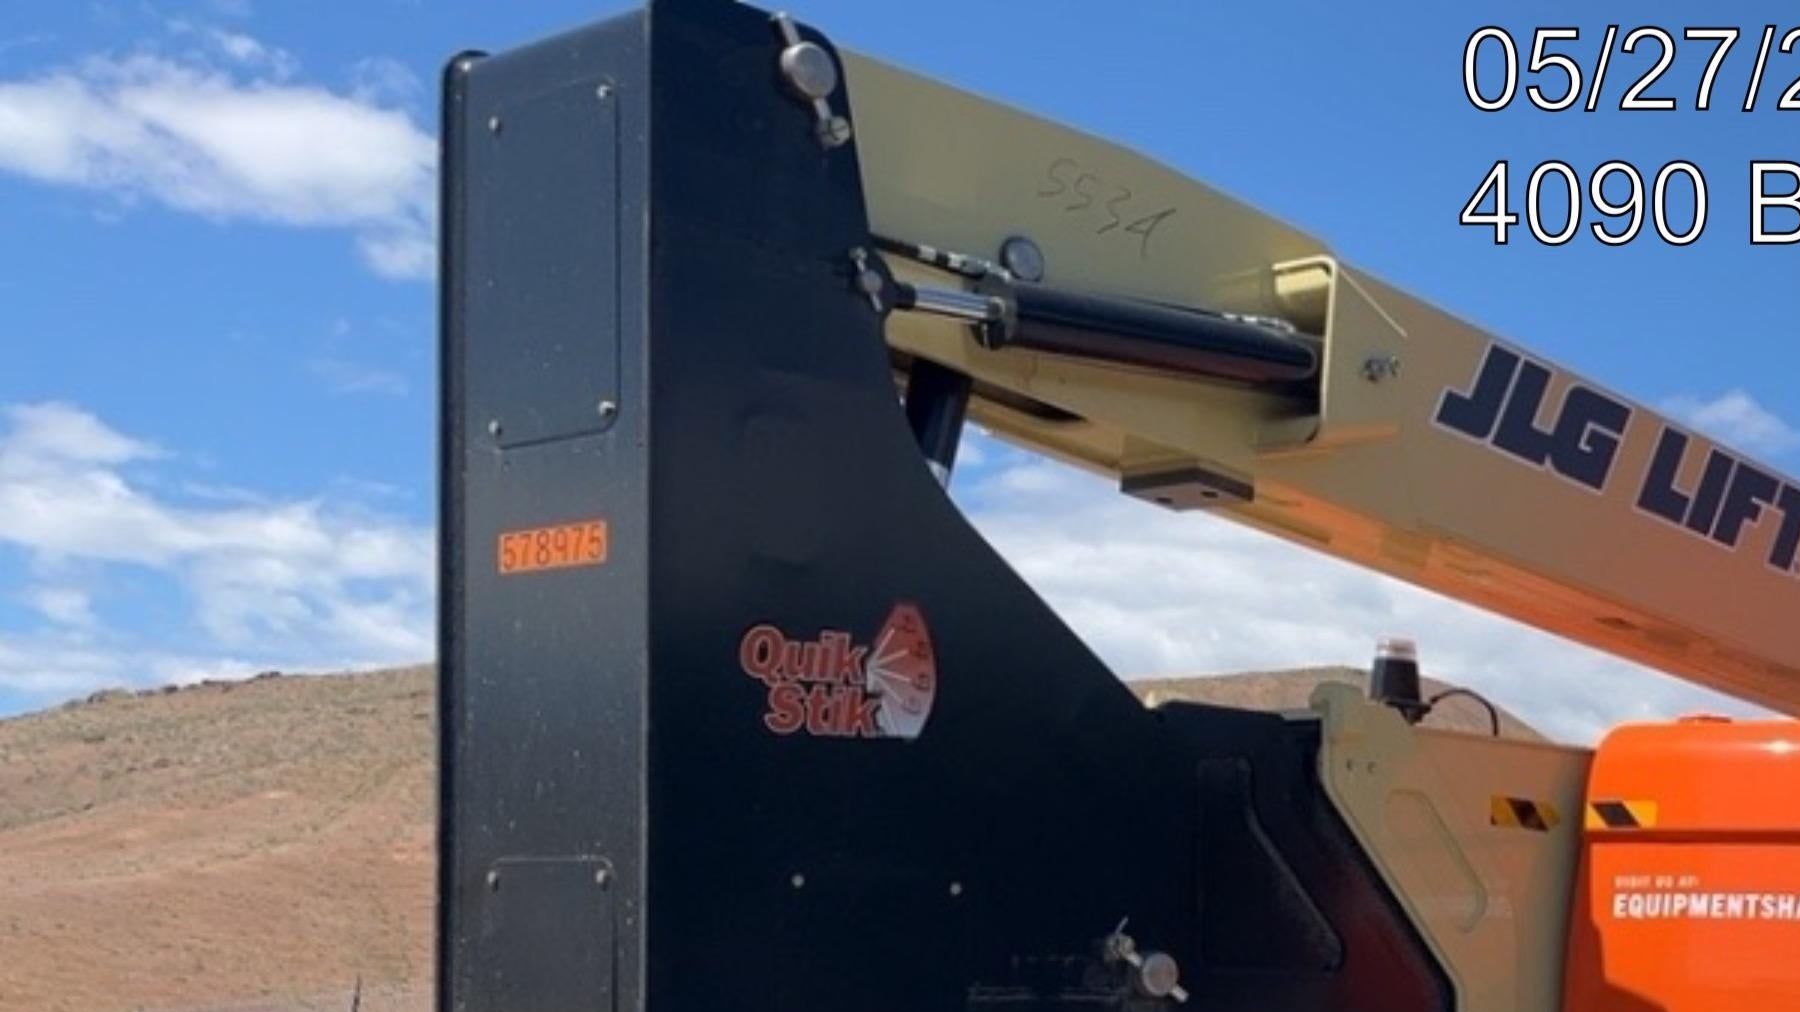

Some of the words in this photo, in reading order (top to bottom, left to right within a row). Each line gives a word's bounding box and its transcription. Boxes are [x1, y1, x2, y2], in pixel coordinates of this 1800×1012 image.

[1433, 340, 1634, 494] JLG
[502, 523, 603, 571] 578975
[740, 624, 869, 685] Quik
[765, 683, 878, 737] Stik
